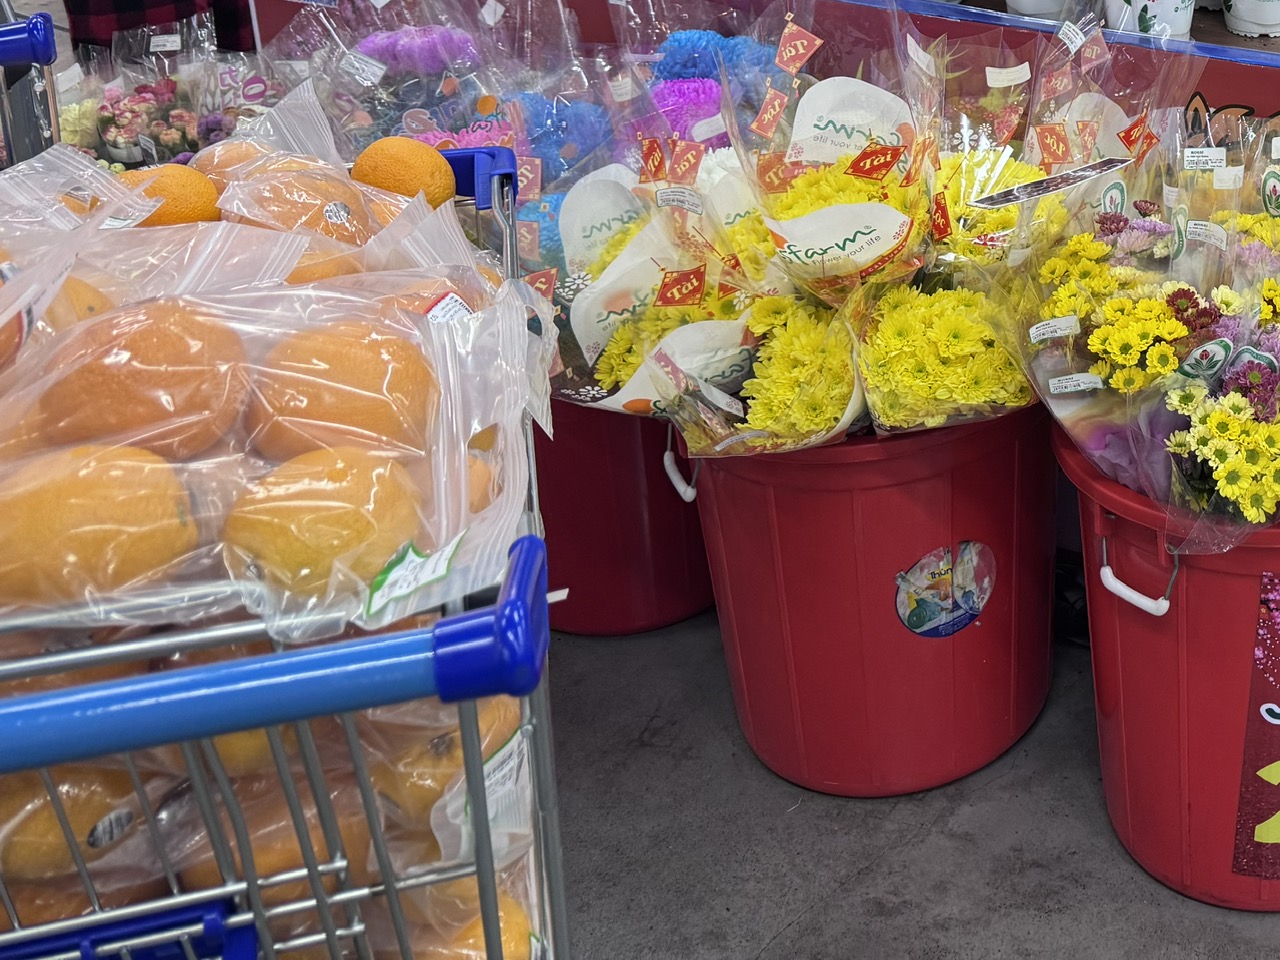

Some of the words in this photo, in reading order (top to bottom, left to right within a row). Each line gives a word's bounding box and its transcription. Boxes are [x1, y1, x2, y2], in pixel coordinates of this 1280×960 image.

[859, 150, 893, 169] Tài
[843, 243, 864, 260] your
[865, 234, 882, 248] life
[667, 275, 700, 300] Tài
